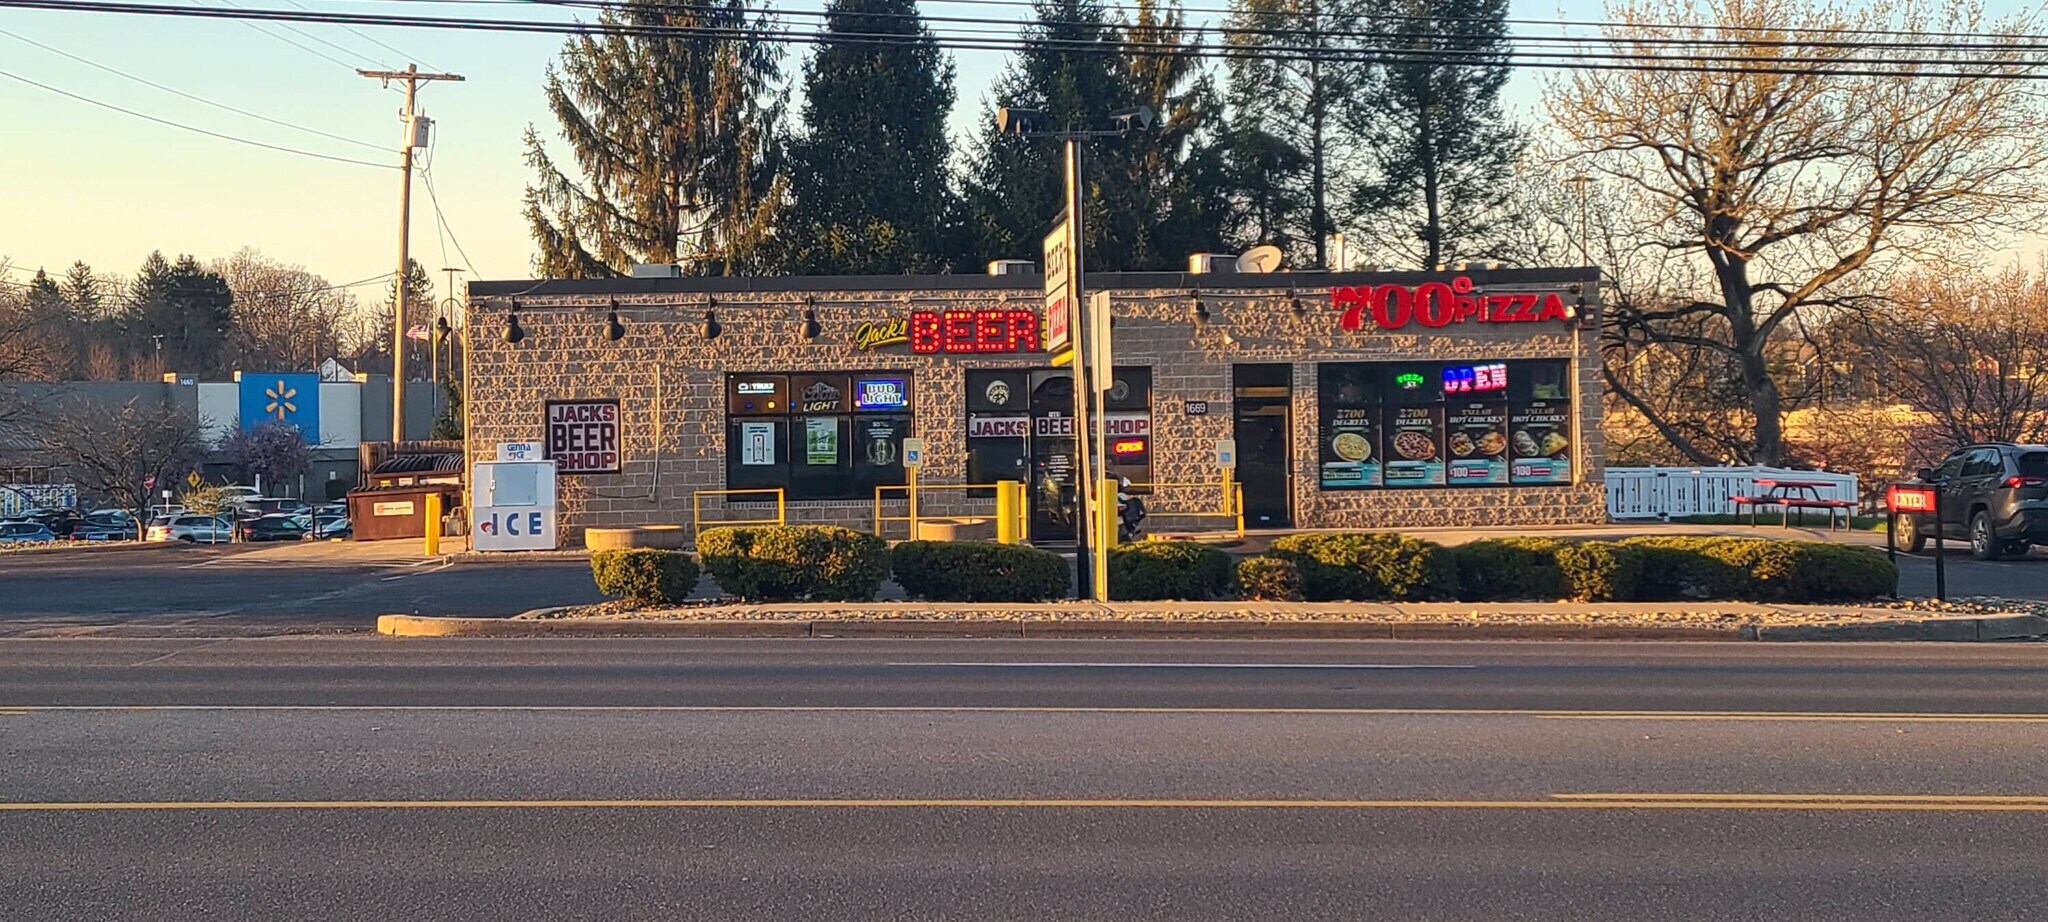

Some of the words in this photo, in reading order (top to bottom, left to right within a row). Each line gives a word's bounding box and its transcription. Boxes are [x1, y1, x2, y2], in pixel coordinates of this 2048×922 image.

[1454, 294, 1568, 323] PIZZA
[855, 317, 908, 349] Jack's
[911, 311, 1037, 353] BEER
[1442, 364, 1507, 393] OPEN
[866, 383, 896, 395] BUD
[803, 401, 839, 412] LIGHT
[861, 393, 902, 405] LIGHT
[552, 405, 615, 423] JACKS
[1185, 403, 1207, 414] 1669
[971, 421, 1028, 436] JACKS
[1038, 419, 1076, 435] BEE
[552, 423, 616, 453] BEER
[552, 452, 617, 470] SHOP
[1894, 492, 1927, 508] ENTER
[492, 512, 542, 535] ICE
